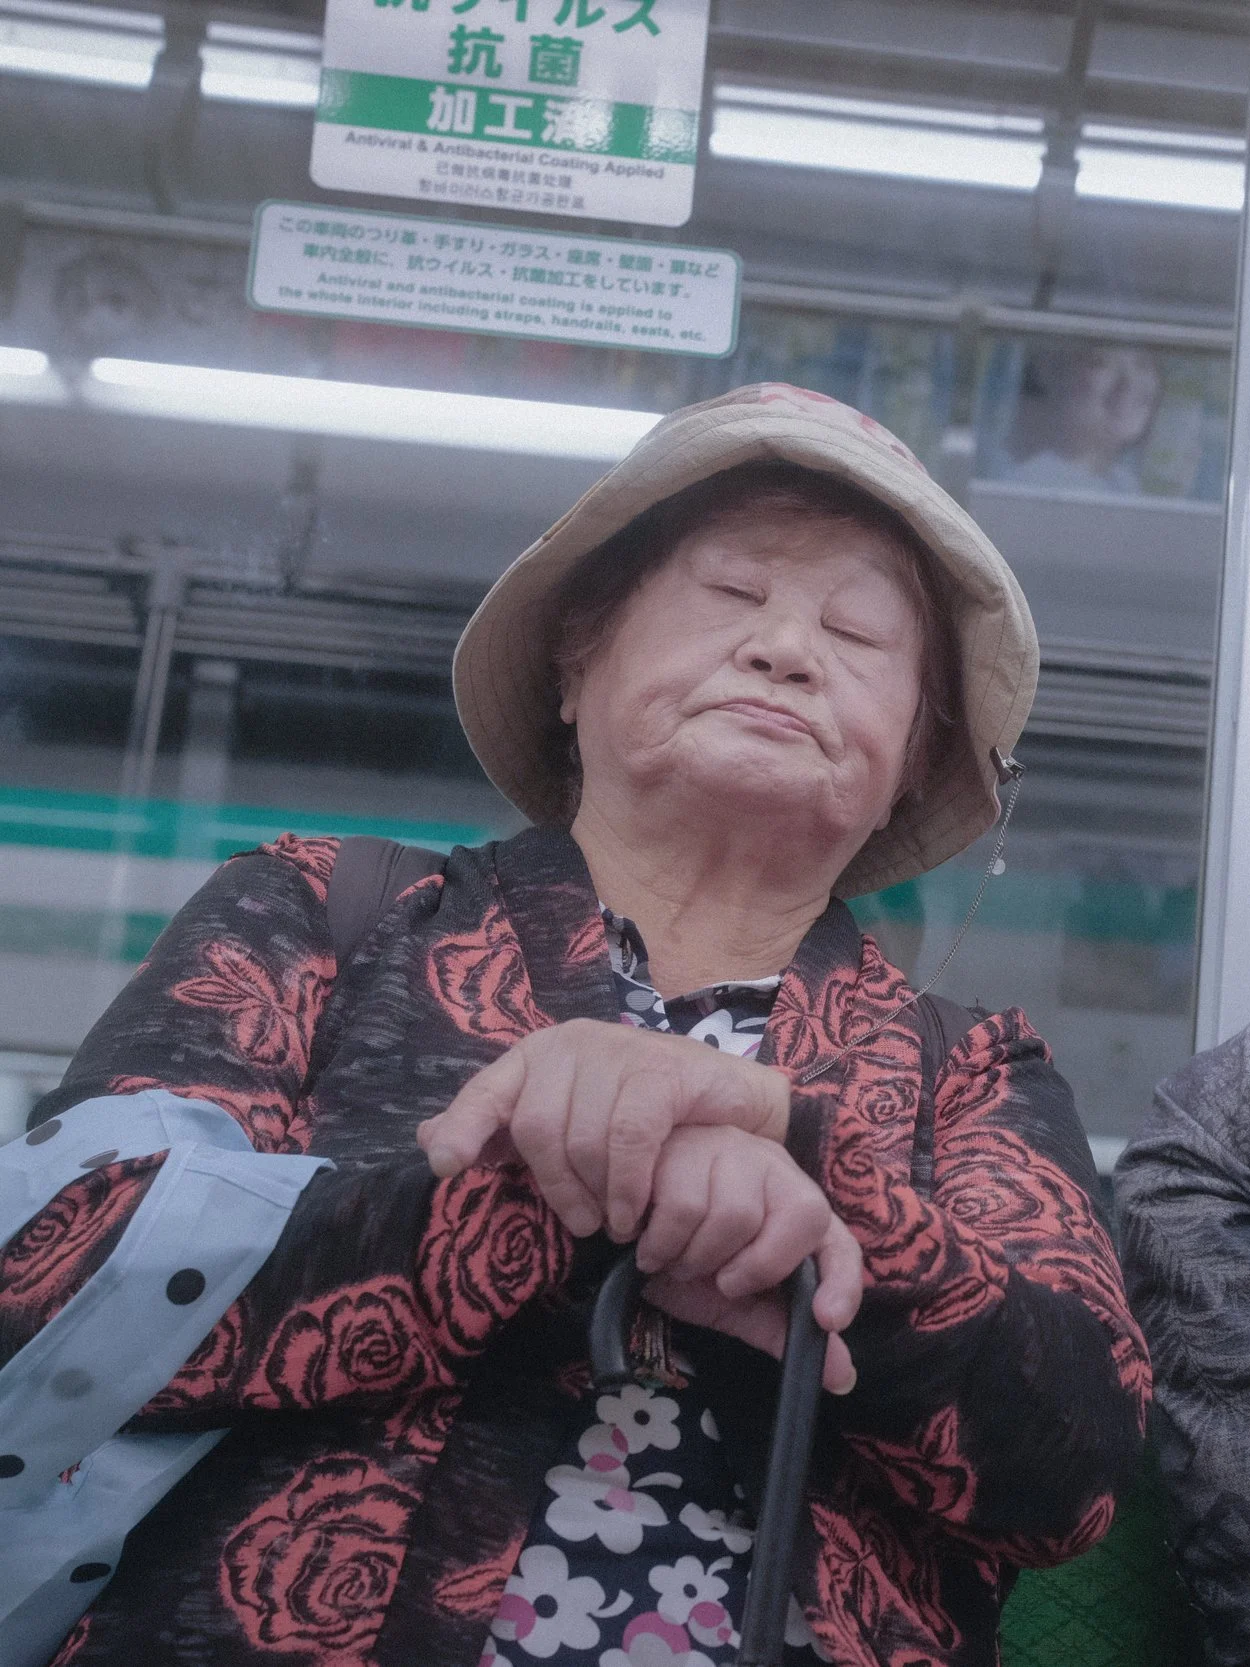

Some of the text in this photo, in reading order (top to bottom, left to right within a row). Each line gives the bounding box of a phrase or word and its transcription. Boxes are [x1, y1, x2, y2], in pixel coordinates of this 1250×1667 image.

[447, 24, 583, 87] 抗菌
[344, 131, 666, 180] Antiviral & Antibacterial Coating Applied
[278, 285, 707, 342] the whole interior including straps, handrails, seats, etc.
[317, 272, 673, 321] Antiviral and antibacterial coating is applied to
